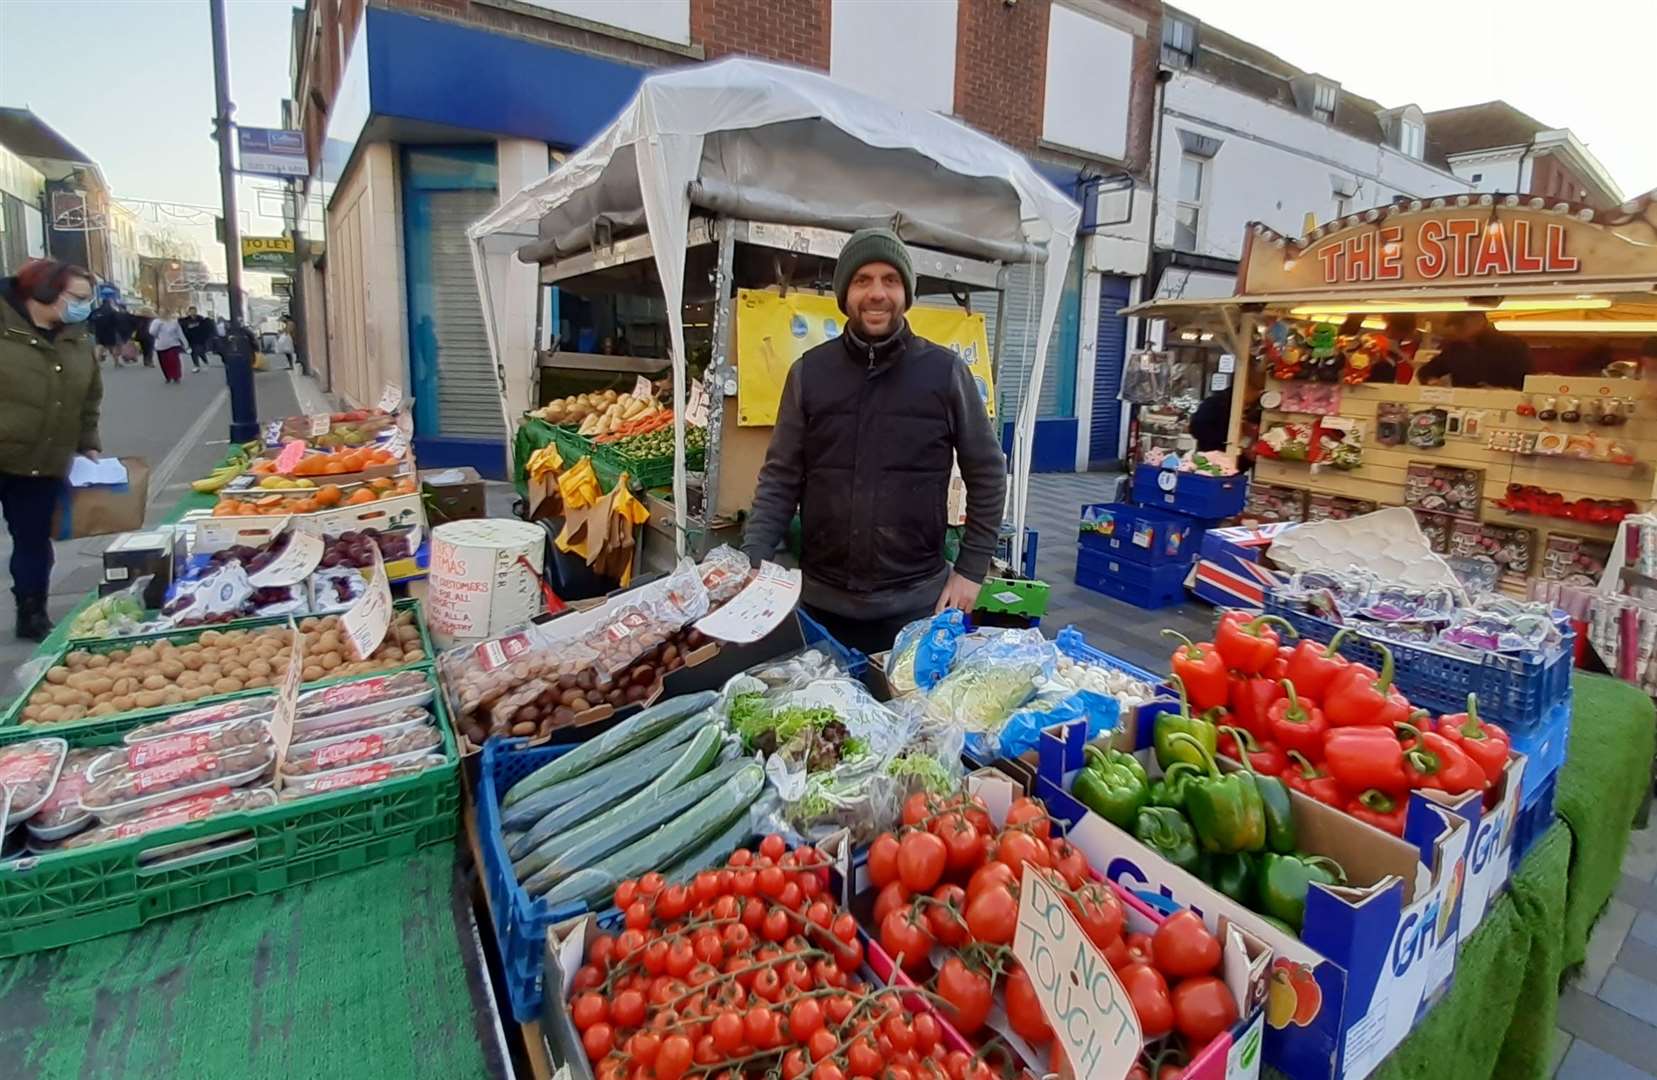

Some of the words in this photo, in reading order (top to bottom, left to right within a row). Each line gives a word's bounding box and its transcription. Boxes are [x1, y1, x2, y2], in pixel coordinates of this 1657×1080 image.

[246, 239, 263, 249] TO
[266, 239, 291, 249] LET
[1318, 226, 1402, 283] THE
[1416, 218, 1578, 279] STALL
[440, 579, 488, 592] CUSTOMERS
[455, 592, 472, 602] ALL
[1031, 879, 1065, 940] DO
[1074, 941, 1136, 1046] NOT
[1020, 921, 1102, 1080] TOUCH
